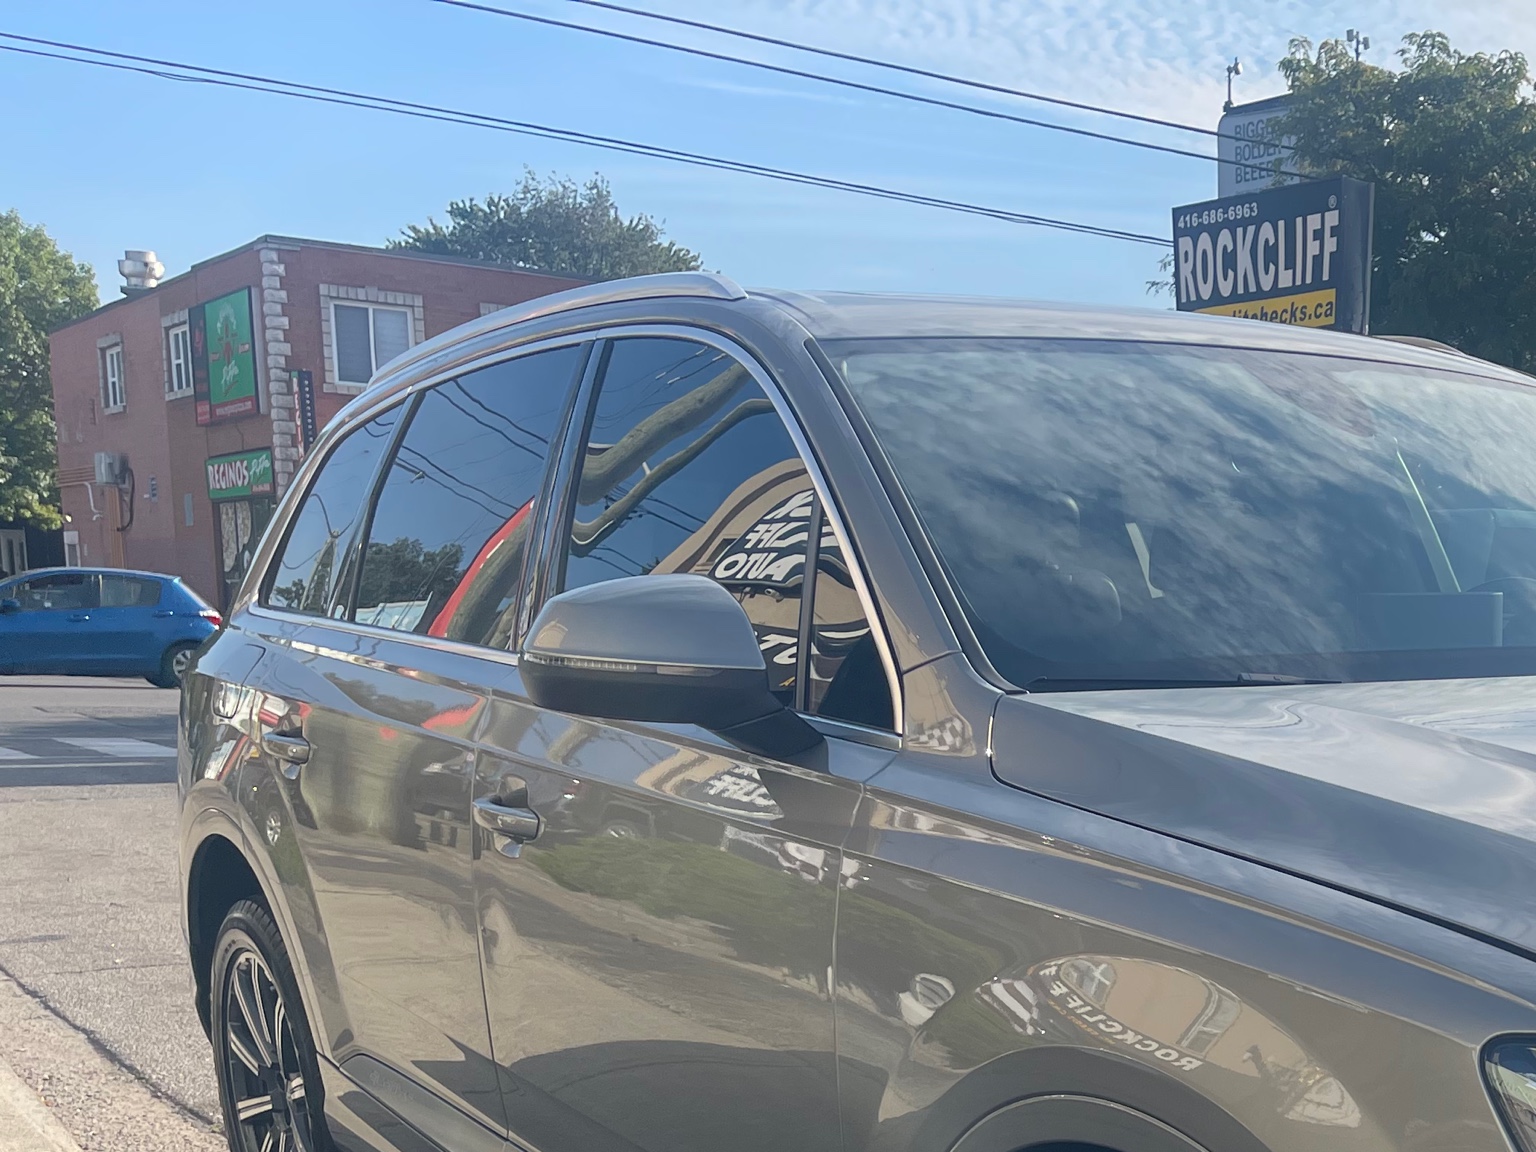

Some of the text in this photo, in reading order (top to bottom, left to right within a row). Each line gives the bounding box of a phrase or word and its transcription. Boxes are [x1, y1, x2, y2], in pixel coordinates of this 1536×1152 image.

[1177, 202, 1258, 229] 416-686-6963
[1178, 209, 1340, 303] ROCKCLIFF
[207, 460, 249, 490] REGINOS
